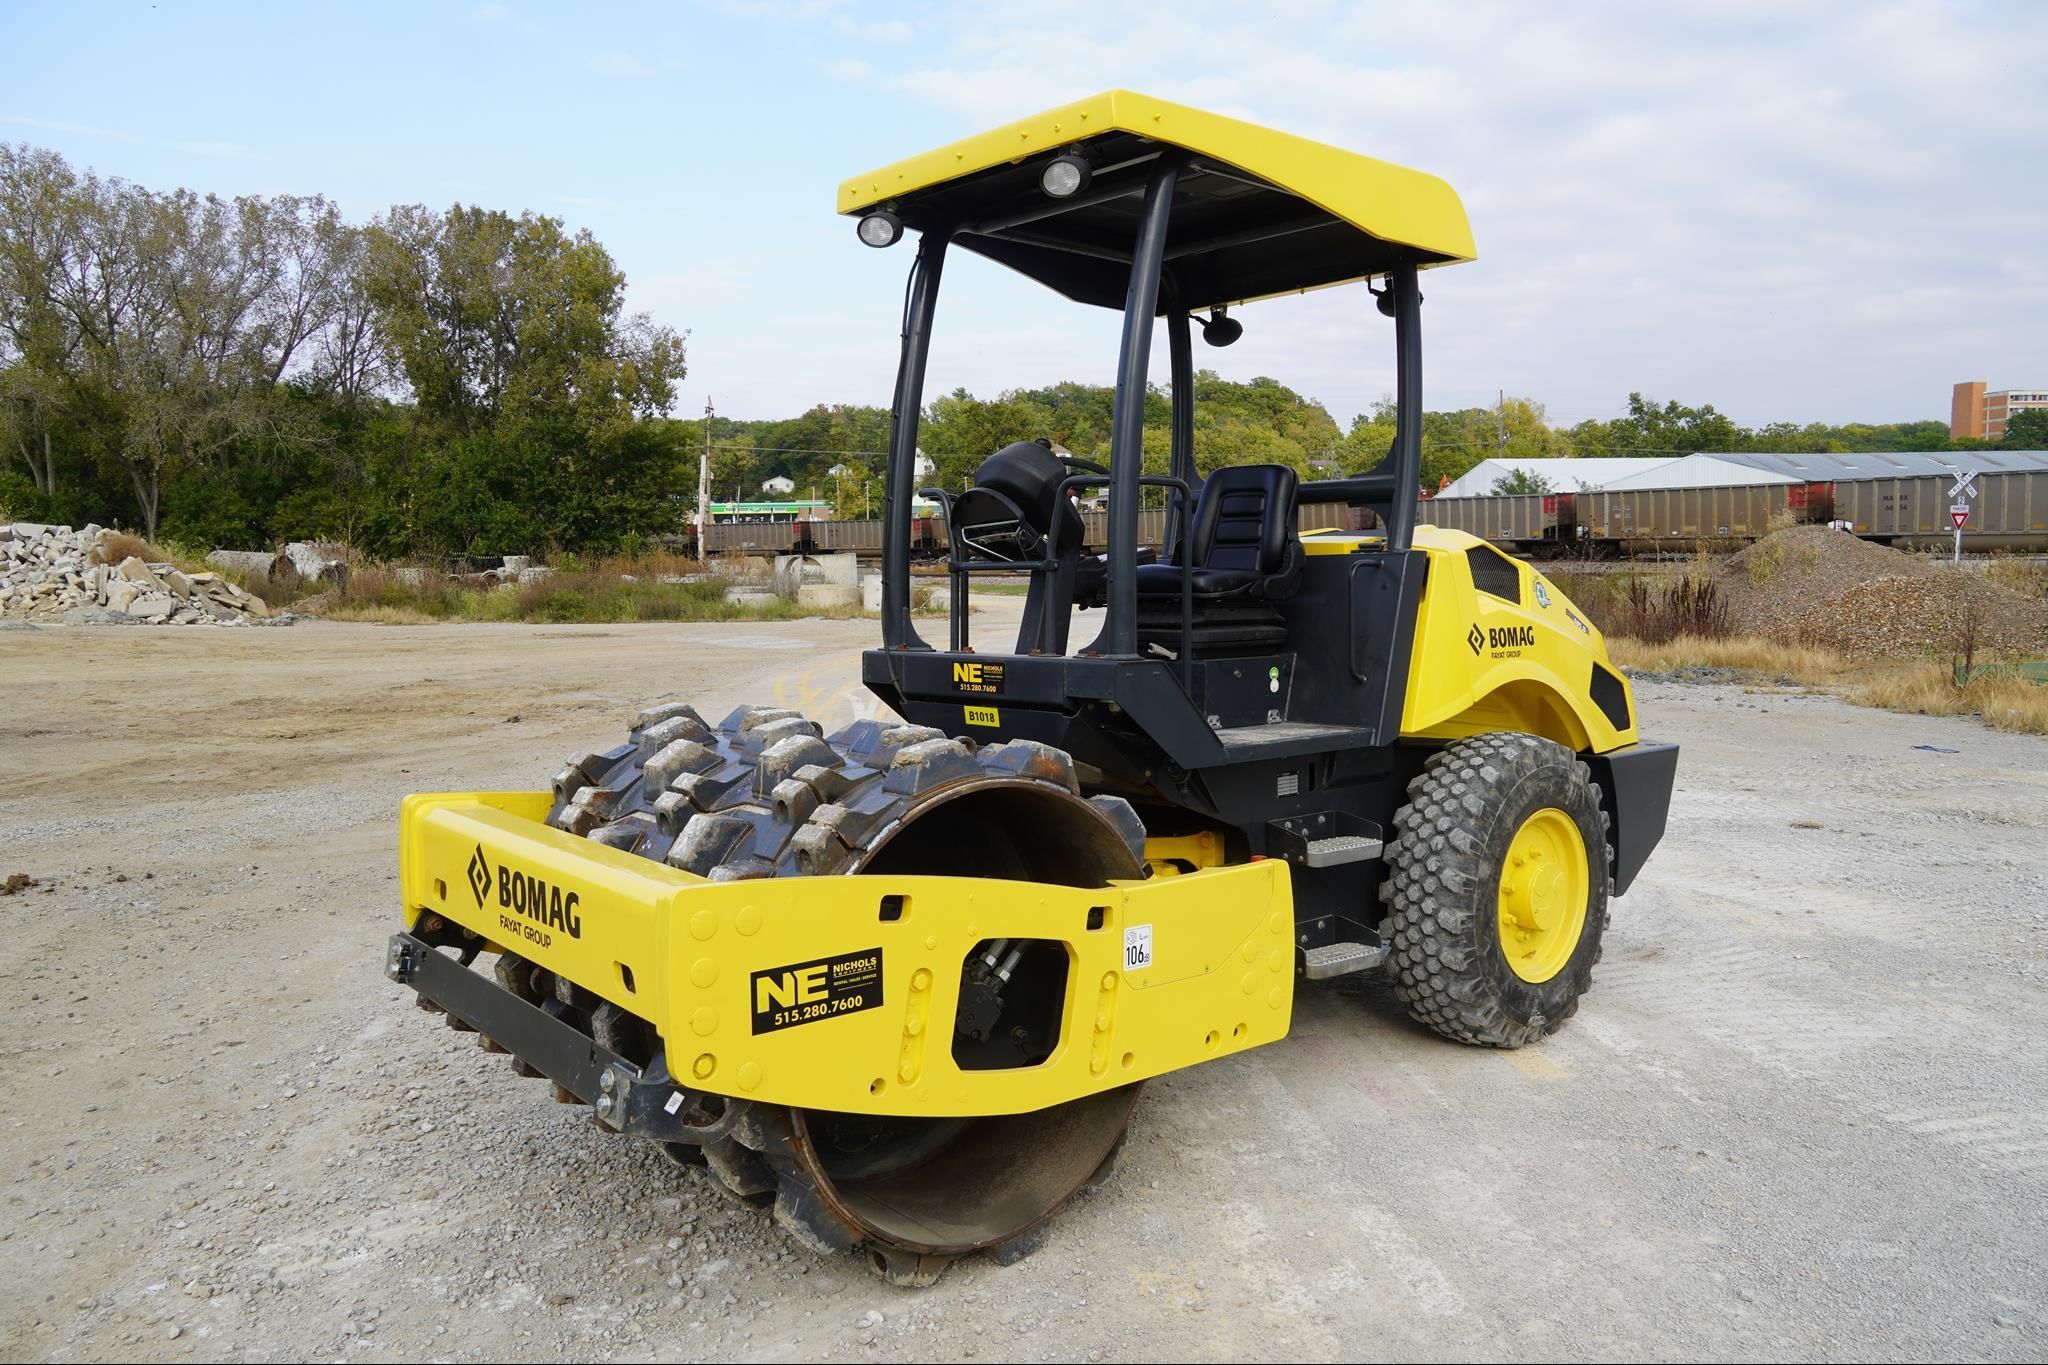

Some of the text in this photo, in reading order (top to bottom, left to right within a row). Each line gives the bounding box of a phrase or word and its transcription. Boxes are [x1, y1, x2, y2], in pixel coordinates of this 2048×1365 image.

[1949, 470, 1977, 497] CROSSING
[1489, 626, 1535, 648] BOMAG
[1491, 650, 1521, 659] FAYAT GROUP
[953, 662, 982, 683] NE
[960, 683, 997, 693] 515.280.7600
[969, 711, 995, 723] B1018
[498, 864, 581, 939] BOMAG
[500, 914, 551, 949] FAYAT GROUP
[833, 956, 877, 974] NICHOLS
[1126, 943, 1144, 966] 106
[756, 964, 829, 1014] NE
[774, 995, 863, 1026] 515.280.7600
